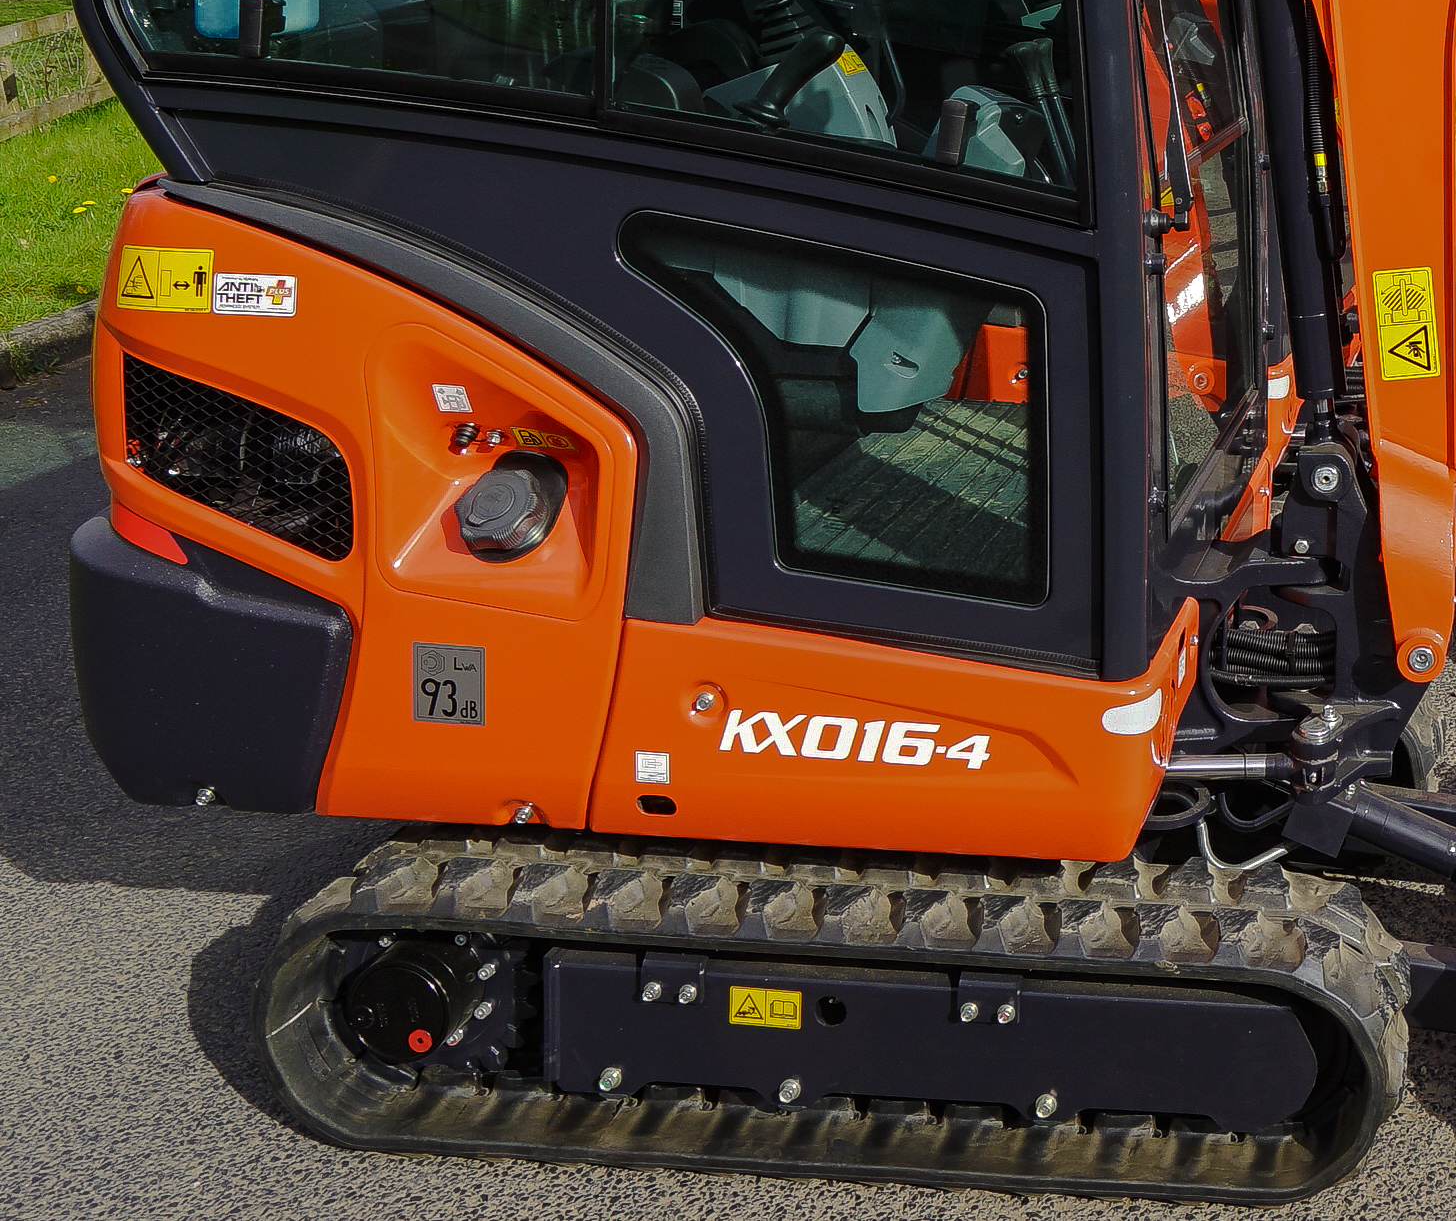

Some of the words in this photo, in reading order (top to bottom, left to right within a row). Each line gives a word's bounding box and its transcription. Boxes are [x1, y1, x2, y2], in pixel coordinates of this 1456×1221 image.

[217, 281, 254, 293] ANTI
[216, 292, 263, 305] THEFT
[420, 678, 458, 718] 93
